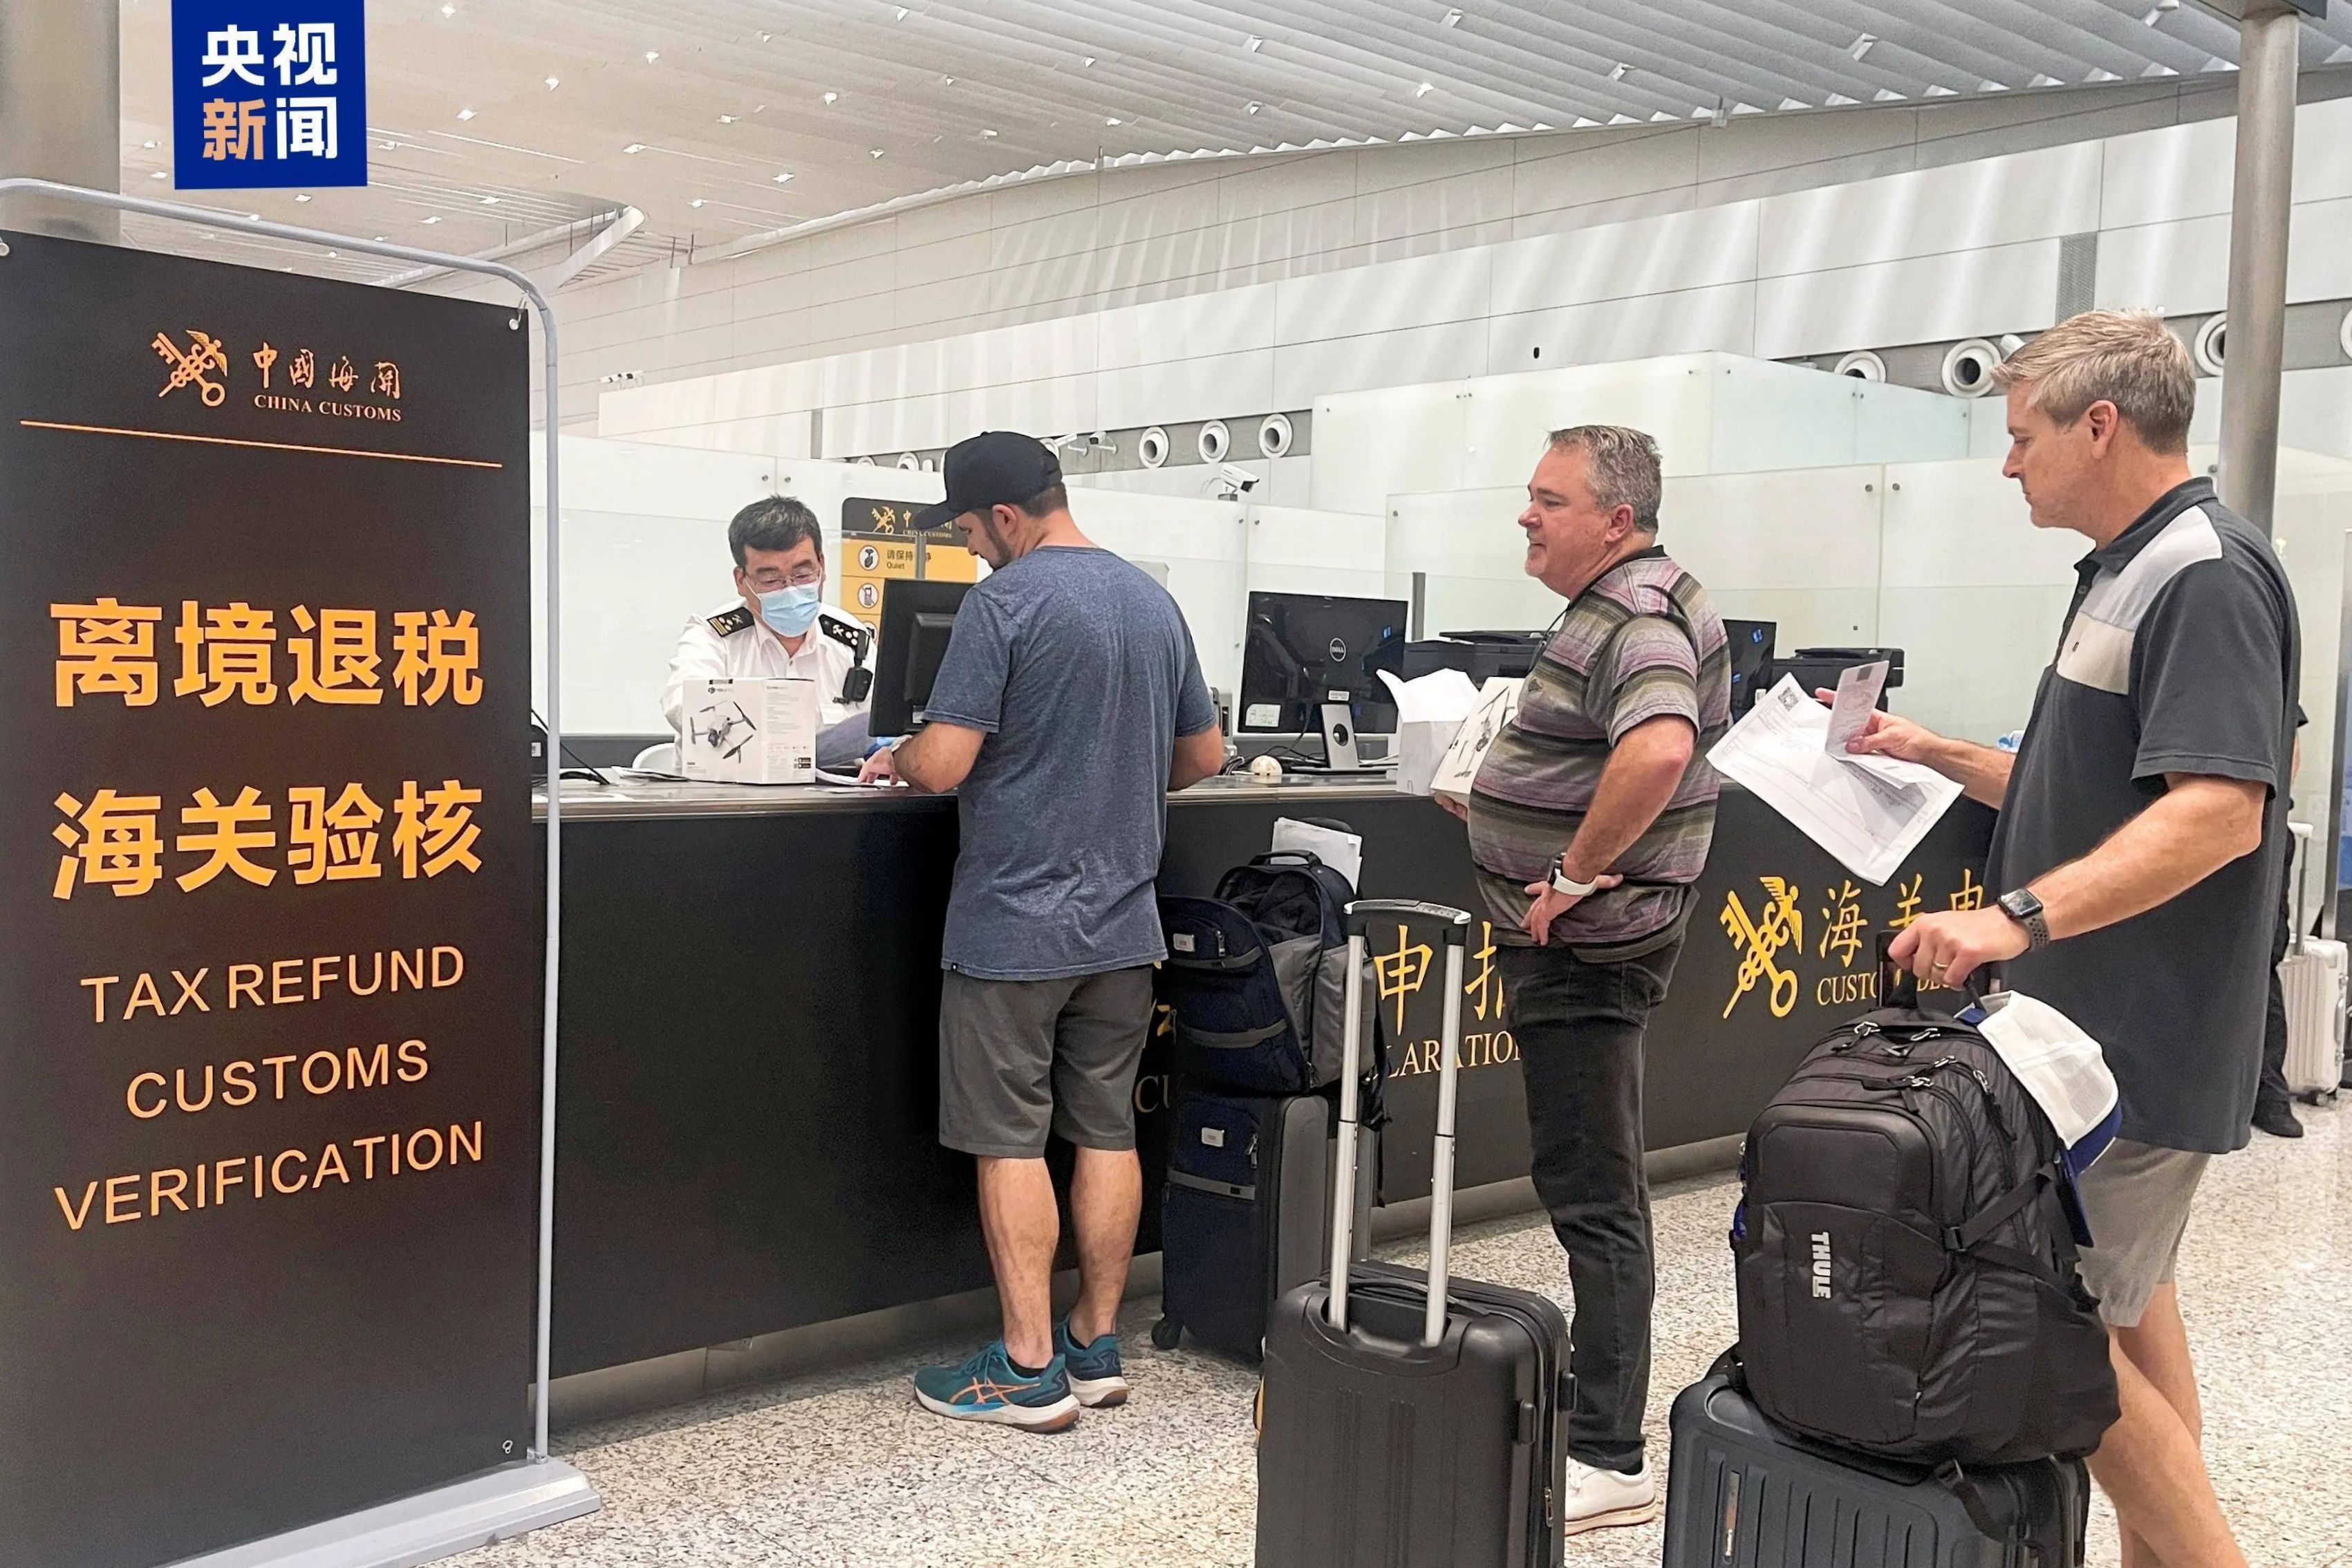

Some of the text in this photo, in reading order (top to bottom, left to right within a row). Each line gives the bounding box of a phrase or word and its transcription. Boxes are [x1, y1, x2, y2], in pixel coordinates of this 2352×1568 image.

[254, 394, 402, 422] CHINA CUSTOMS
[886, 561, 905, 570] Quiet
[50, 597, 483, 707] 离境退税
[52, 779, 483, 899] 海关验核
[80, 945, 464, 1023] TAX REFUND
[127, 1040, 429, 1119] CUSTOMS
[54, 1121, 483, 1230] VERIFICATION
[1811, 1232, 1831, 1298] THULE
